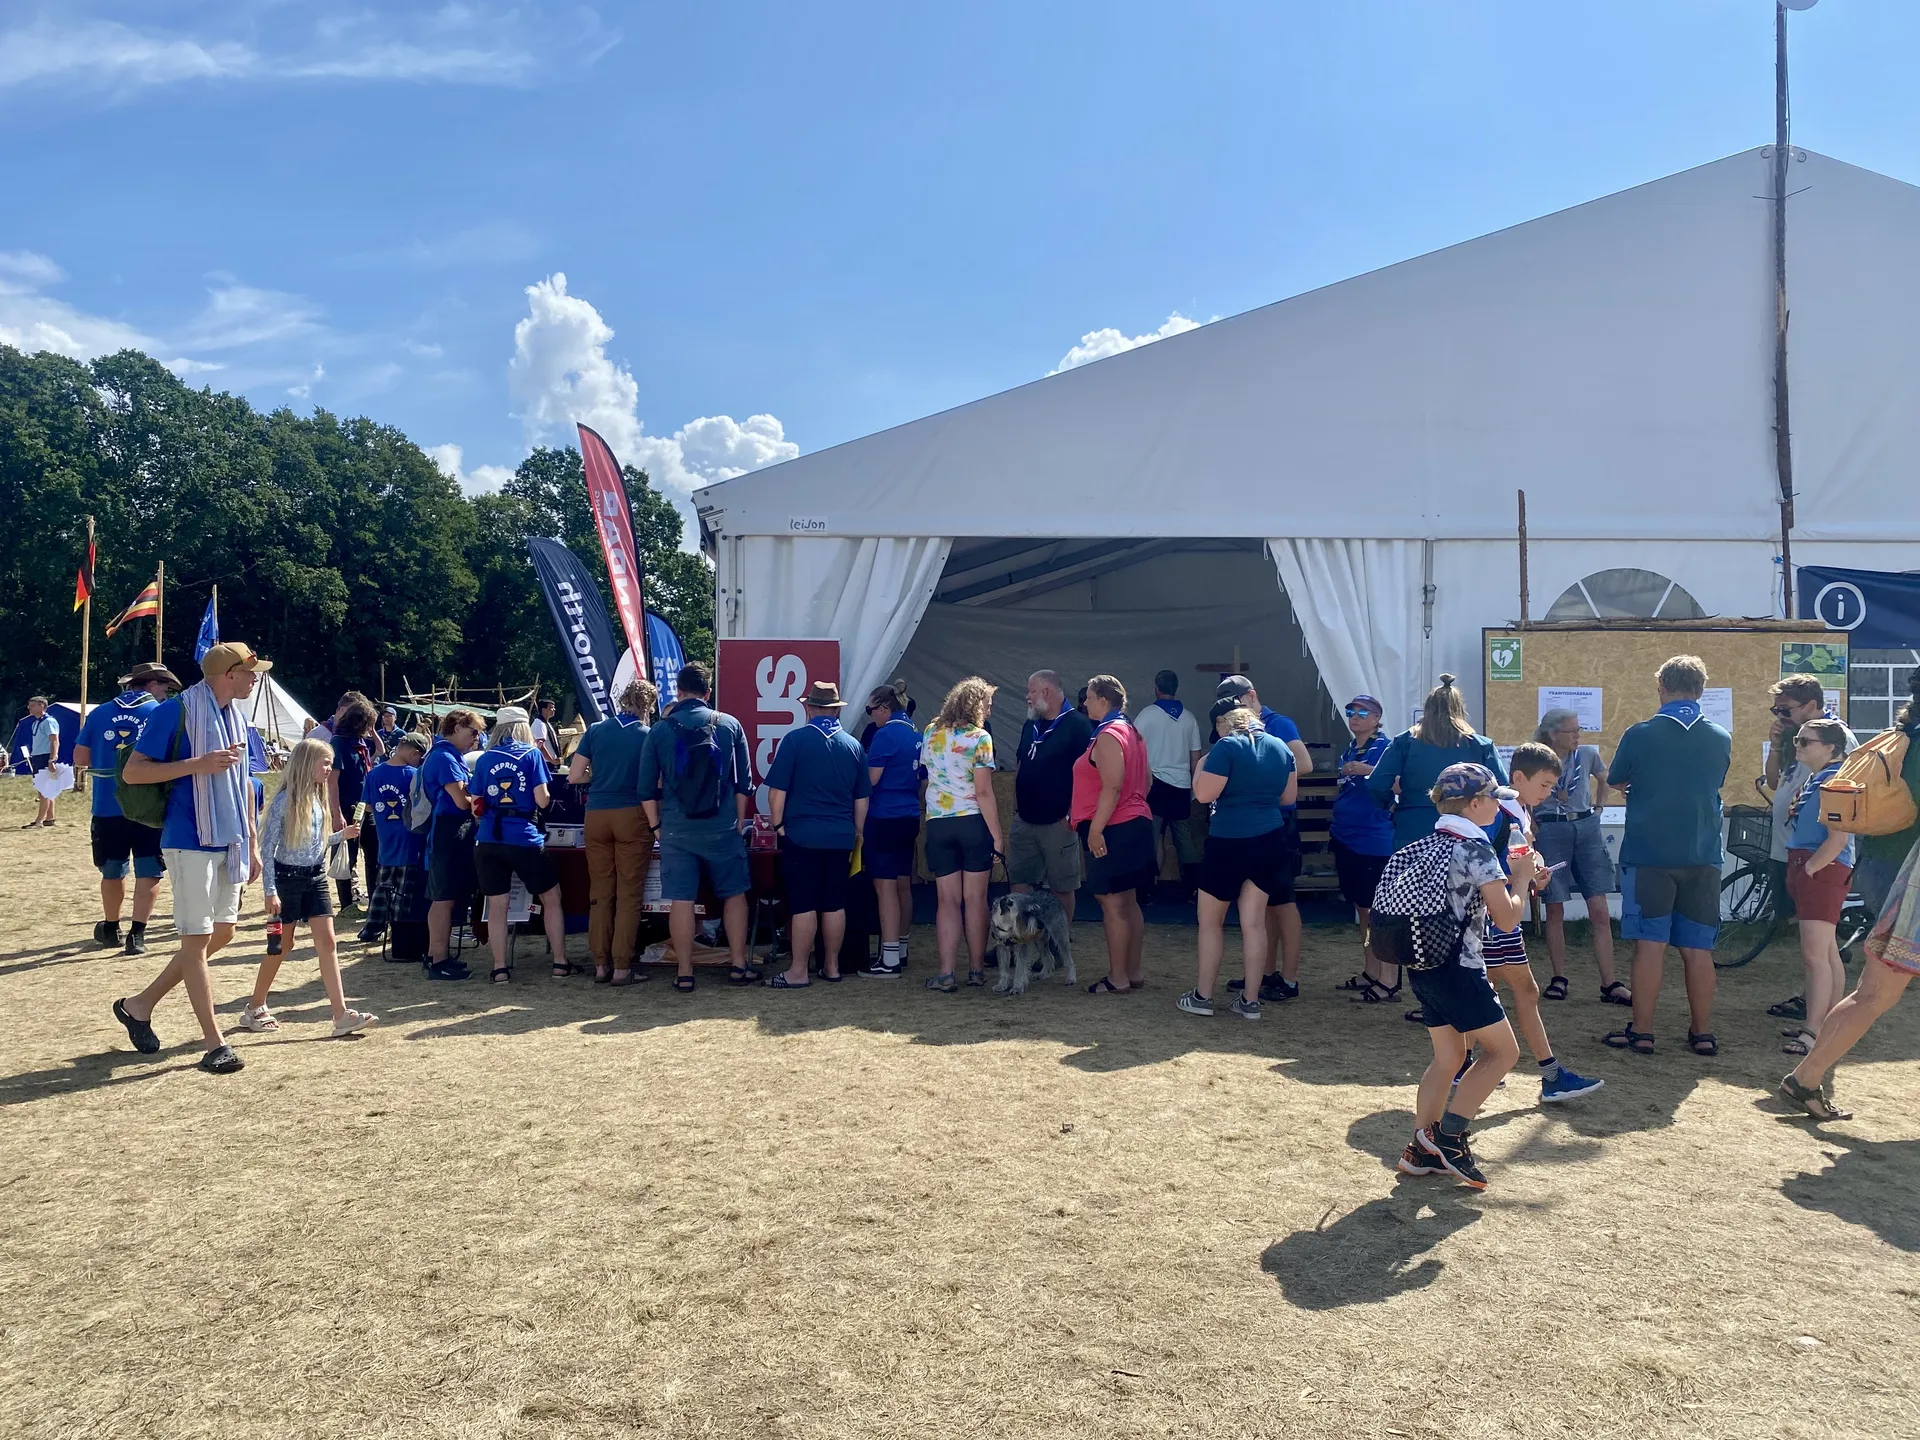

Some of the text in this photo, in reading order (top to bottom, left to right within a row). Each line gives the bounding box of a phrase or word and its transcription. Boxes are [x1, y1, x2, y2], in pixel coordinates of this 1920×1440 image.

[112, 714, 140, 724] REPRIS
[490, 761, 527, 792] REPRIS 2025
[378, 784, 400, 794] REPRIS
